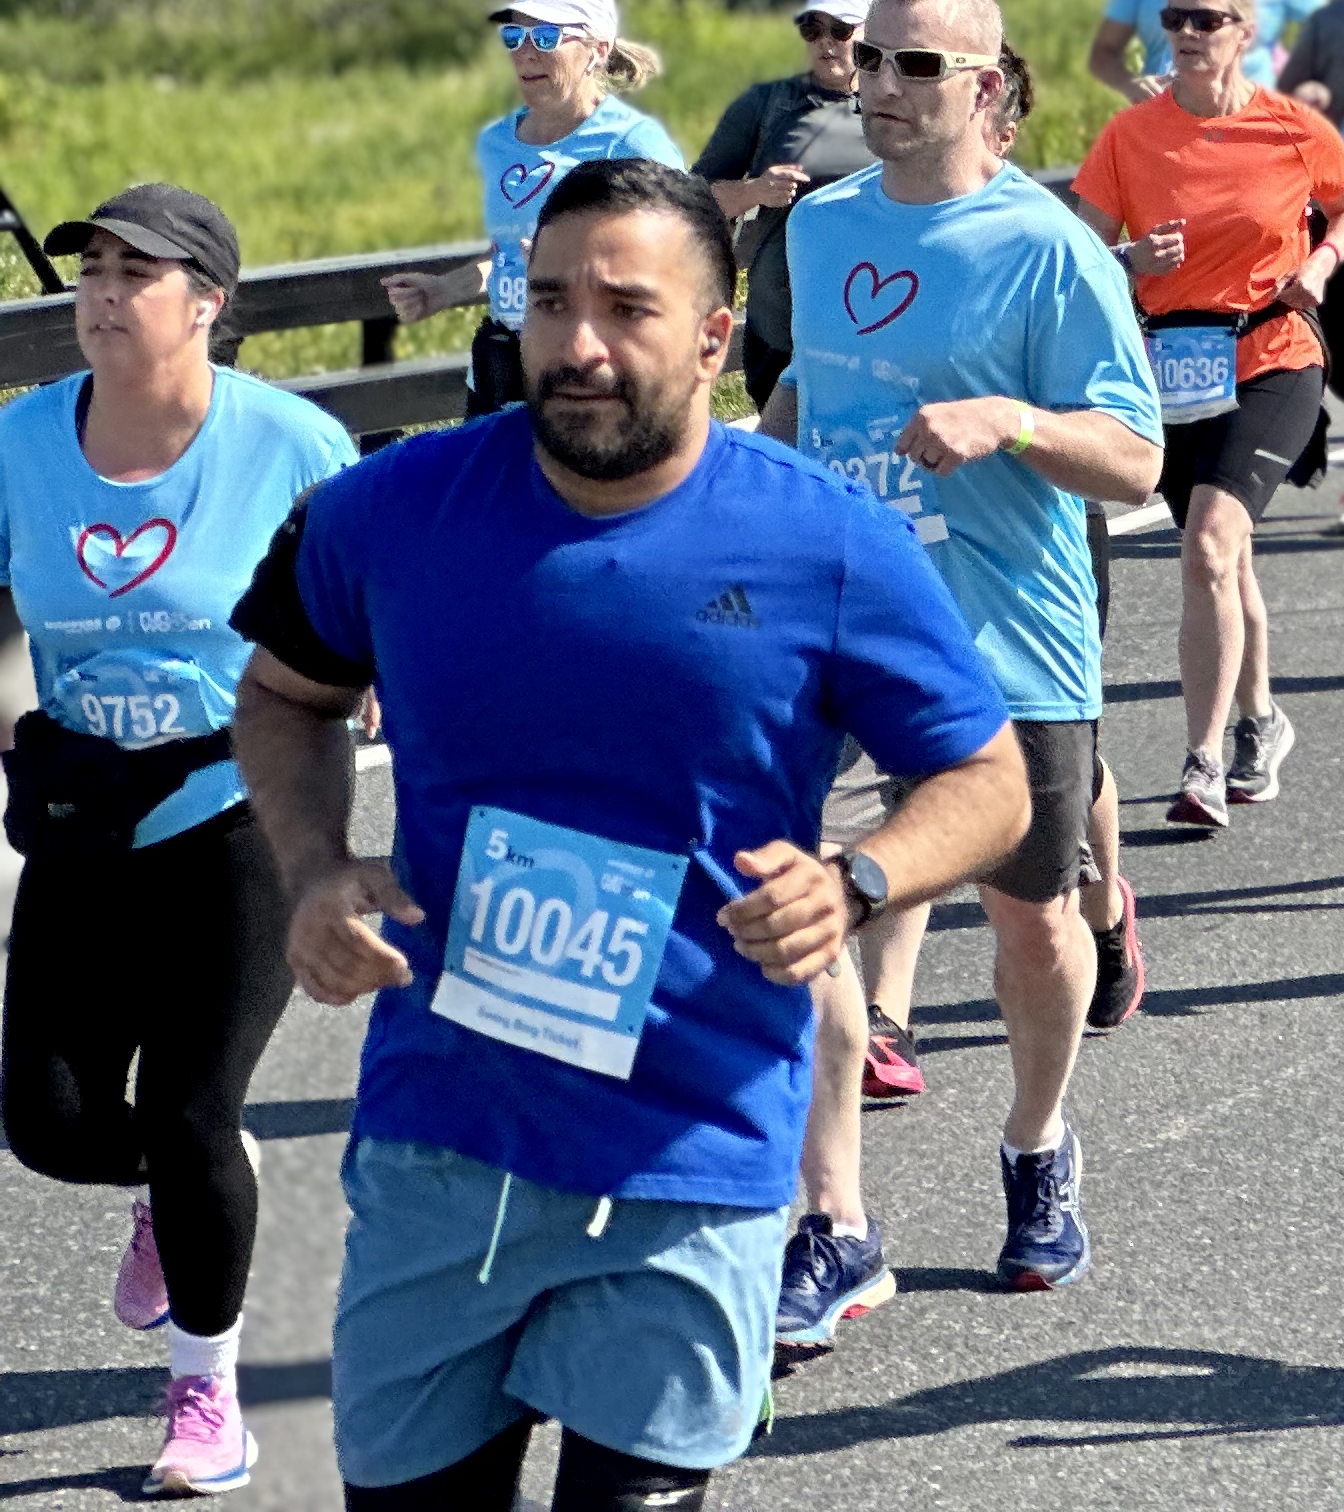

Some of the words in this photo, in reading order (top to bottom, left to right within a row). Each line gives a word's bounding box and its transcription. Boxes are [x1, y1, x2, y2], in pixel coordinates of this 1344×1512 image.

[1156, 356, 1229, 390] 10636
[81, 692, 186, 739] 9752
[485, 827, 536, 870] 5km
[468, 877, 650, 987] 10045
